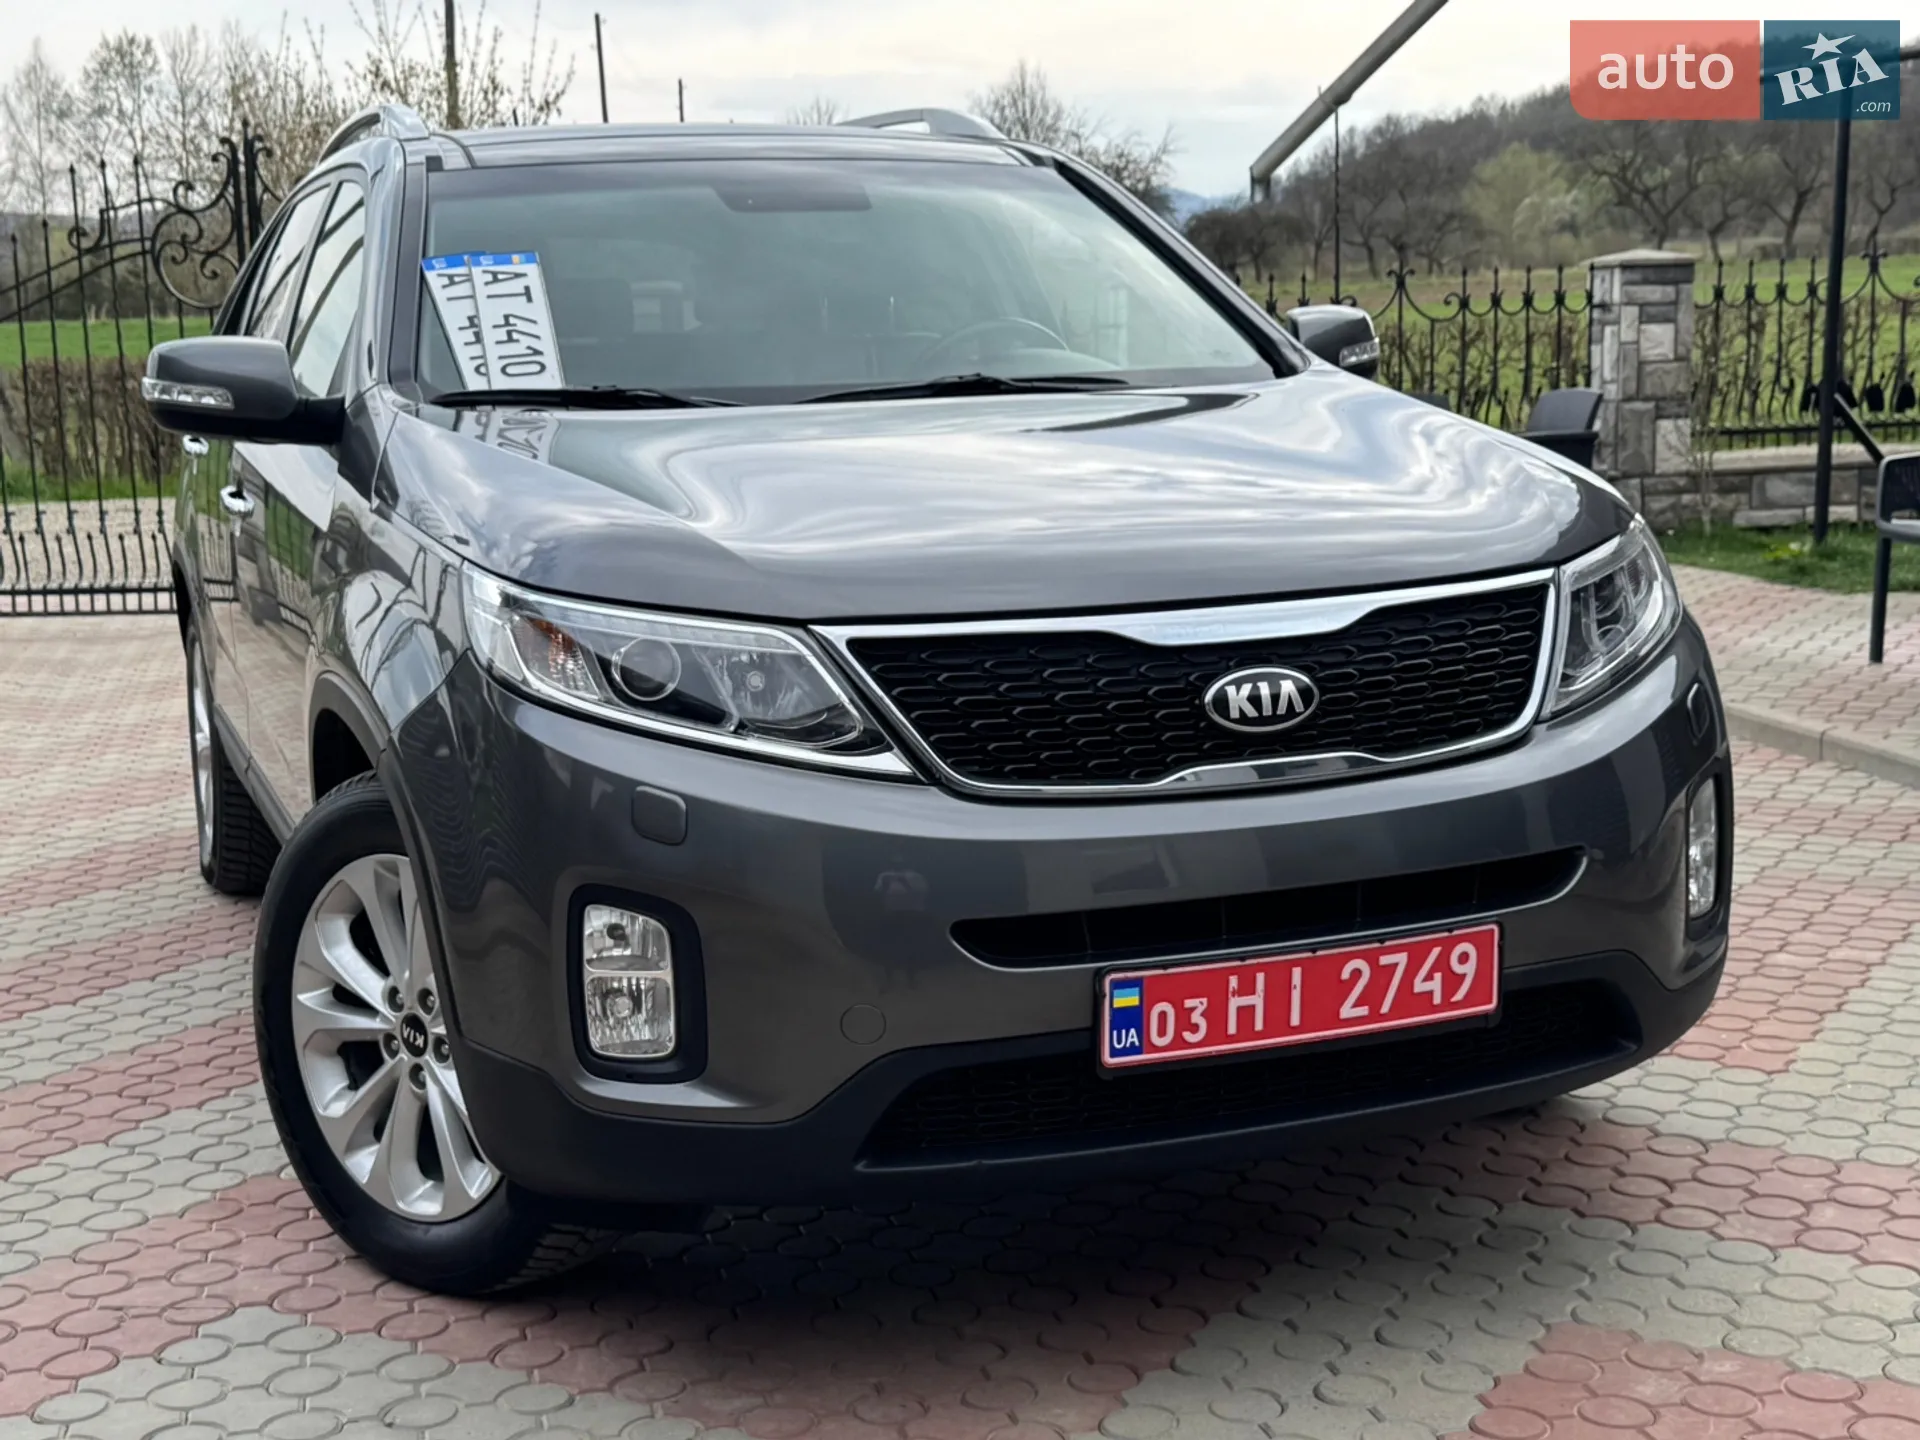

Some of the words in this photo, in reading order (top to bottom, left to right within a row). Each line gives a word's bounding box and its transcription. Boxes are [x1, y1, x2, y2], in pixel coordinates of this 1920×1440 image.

[482, 269, 533, 304] AT
[492, 313, 547, 378] 4410
[1224, 679, 1304, 719] KIA
[1149, 997, 1207, 1047] 03
[1227, 966, 1302, 1035] HI
[1339, 942, 1477, 1020] 2749
[402, 1023, 424, 1049] KIA
[1112, 1028, 1139, 1049] UA
